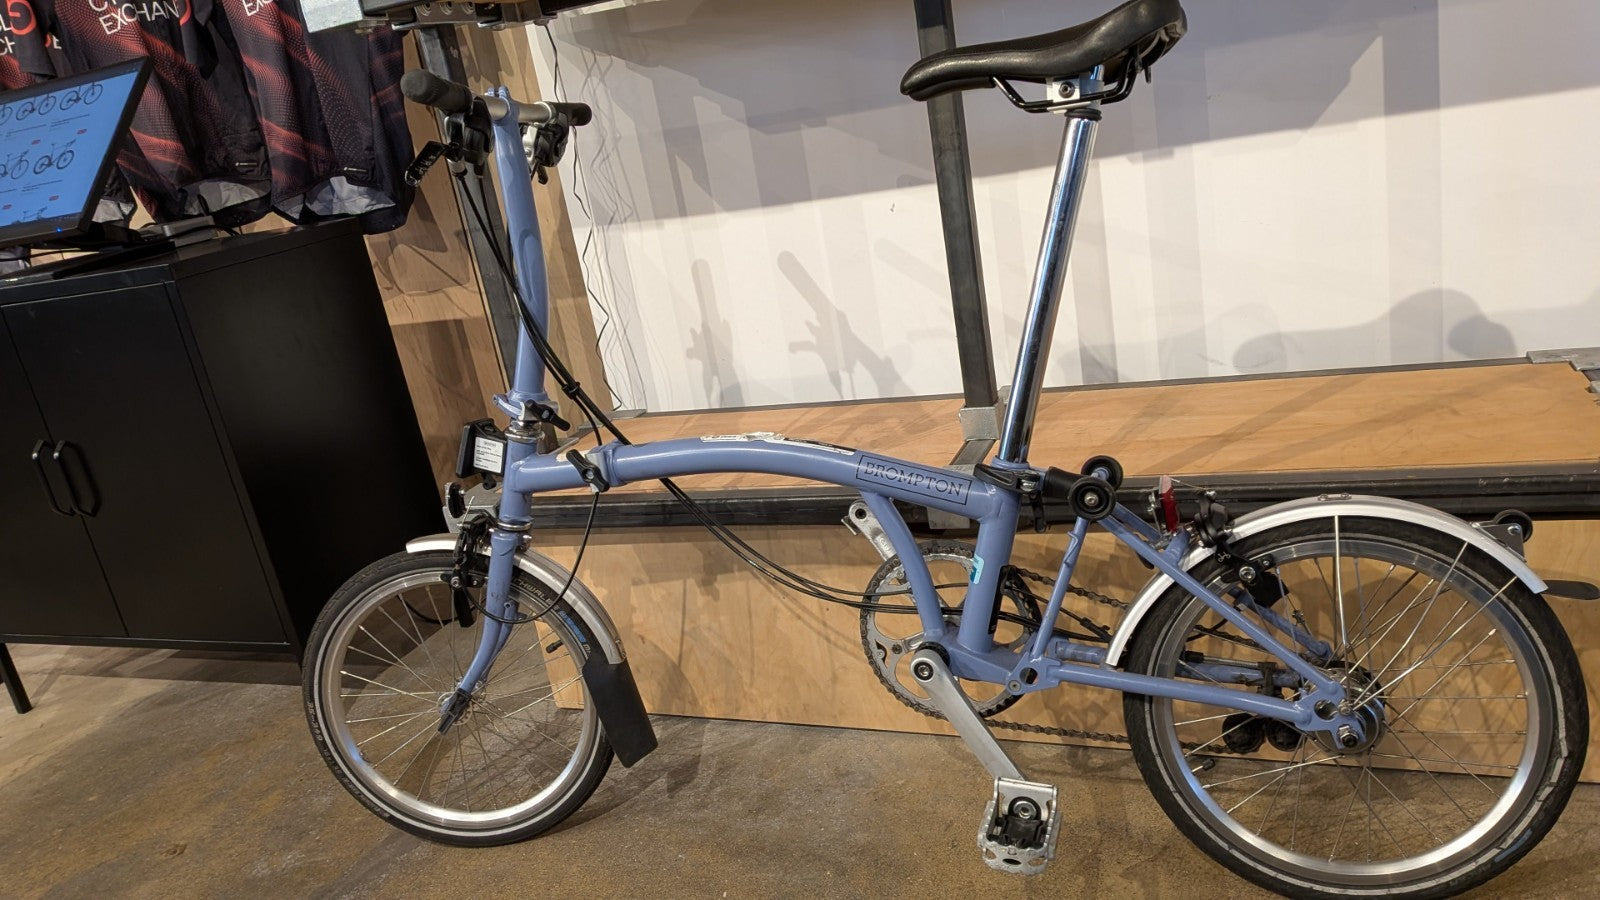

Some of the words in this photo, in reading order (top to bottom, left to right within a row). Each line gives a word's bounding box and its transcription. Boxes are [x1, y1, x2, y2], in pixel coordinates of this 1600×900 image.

[99, 0, 180, 35] EXCHAN
[864, 462, 963, 496] BROMPTON
[515, 578, 560, 609] CHWALB
